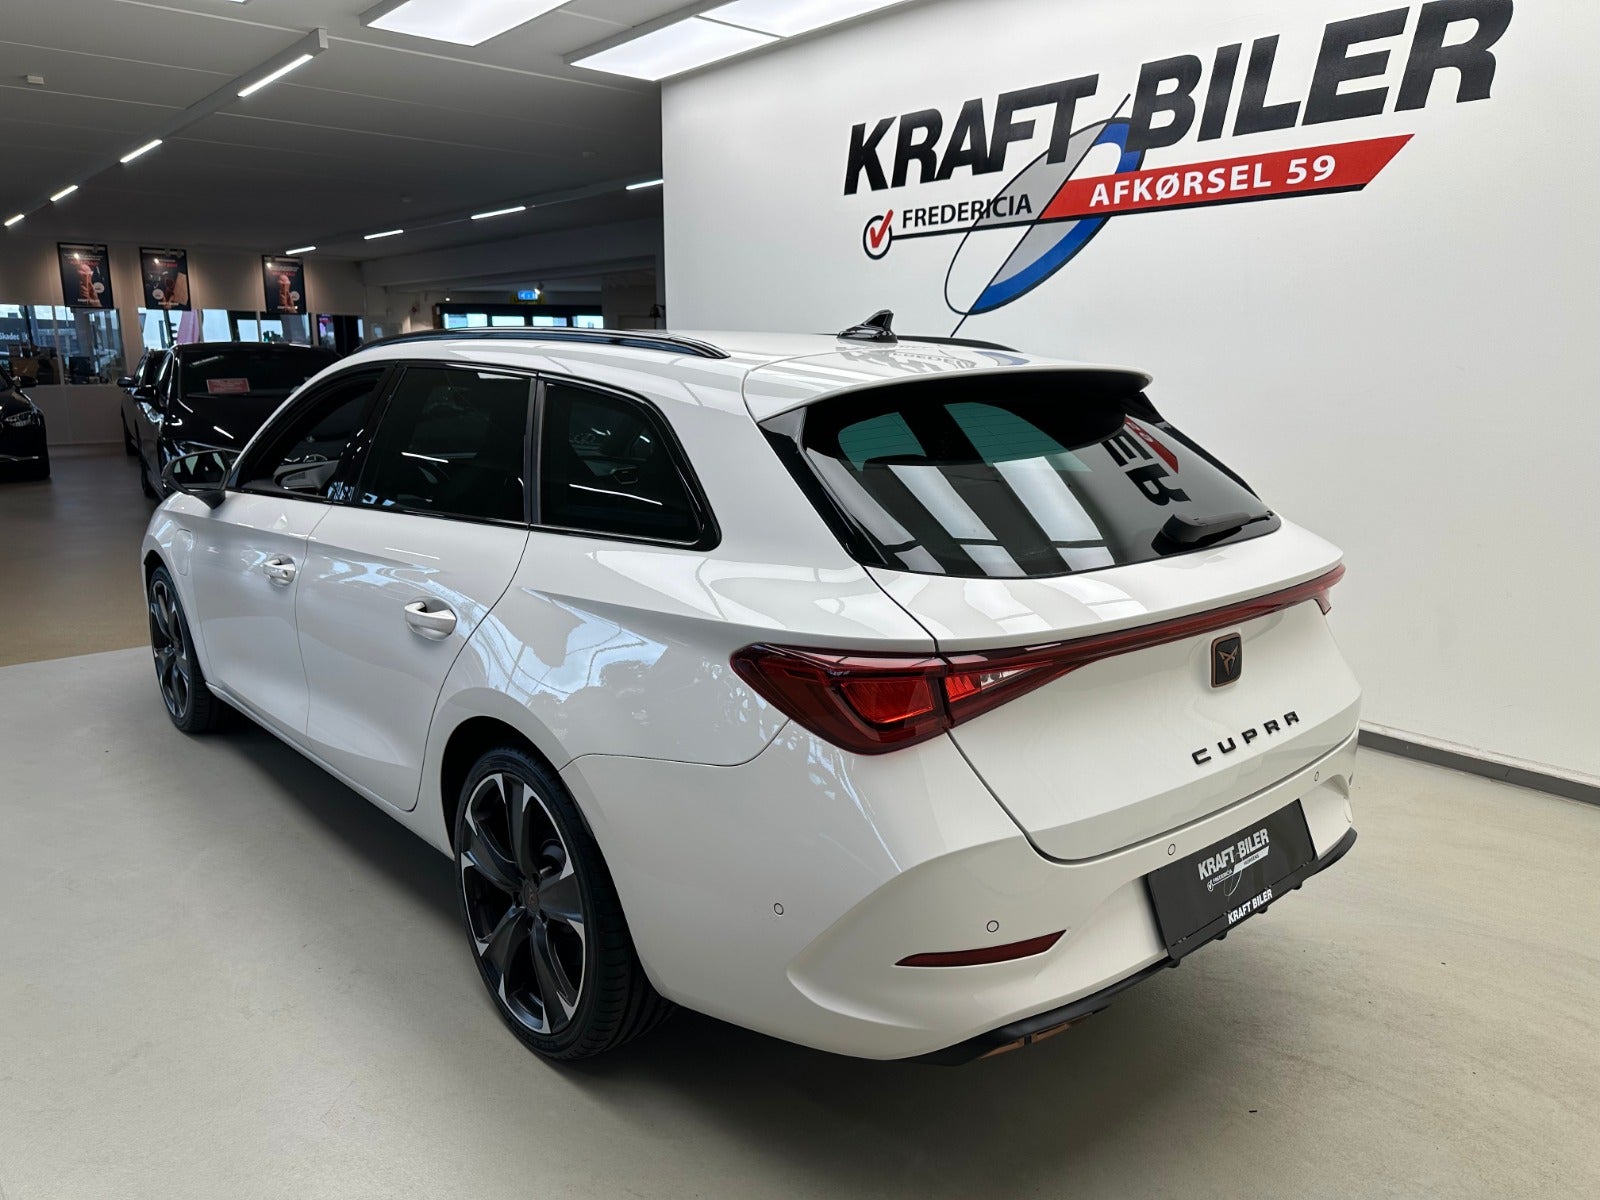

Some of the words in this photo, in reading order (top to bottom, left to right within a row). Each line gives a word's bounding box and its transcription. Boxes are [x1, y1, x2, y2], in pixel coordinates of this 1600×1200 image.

[843, 73, 1100, 195] KRAFT
[1122, 0, 1514, 152] BILER
[1089, 161, 1272, 208] AFKØRSEL
[1285, 154, 1337, 185] 59
[902, 193, 1032, 228] FREDERICIA
[1191, 710, 1300, 766] CUPRA
[1197, 845, 1235, 881] KRAFT
[1237, 828, 1270, 858] BILER
[1227, 901, 1251, 925] KRAFT
[1252, 888, 1273, 909] BILER
